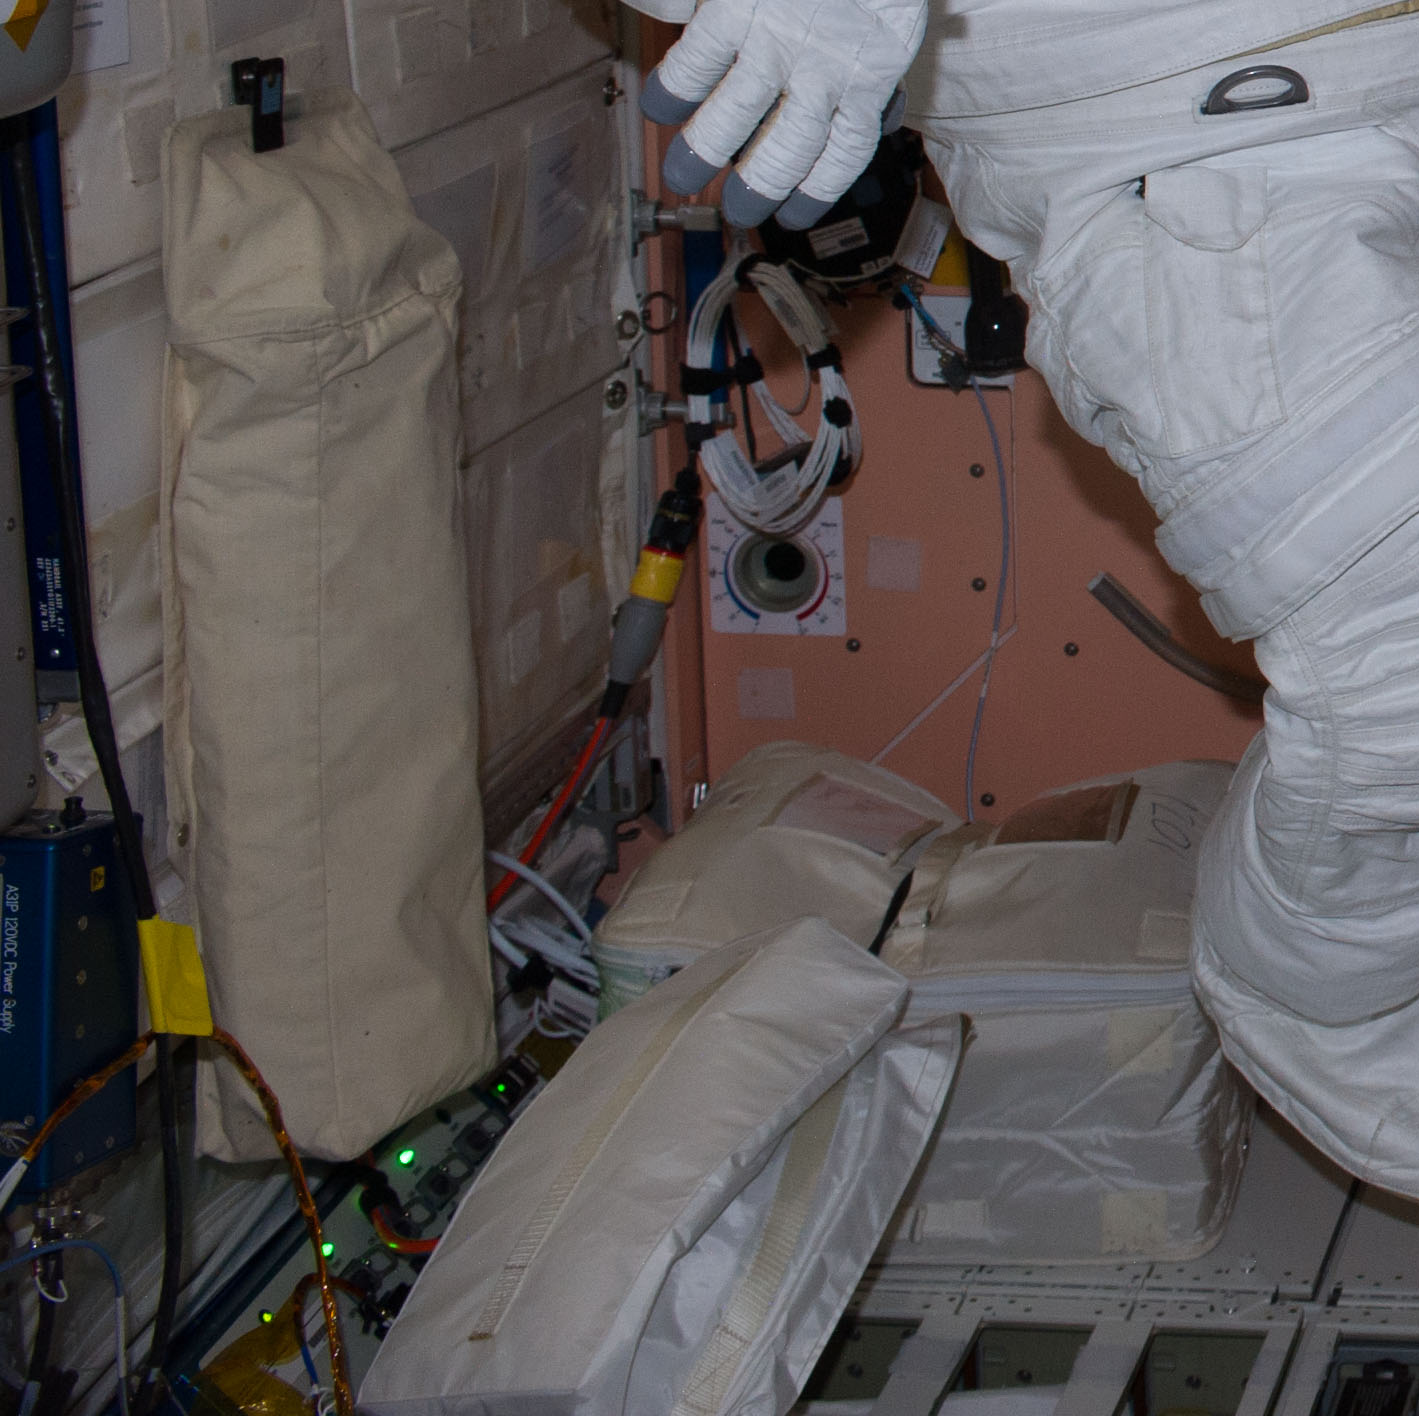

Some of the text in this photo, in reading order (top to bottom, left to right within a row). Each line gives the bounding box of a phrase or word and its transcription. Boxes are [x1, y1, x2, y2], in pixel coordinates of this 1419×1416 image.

[0, 883, 19, 1034] A31P 120VDC Power Supply
